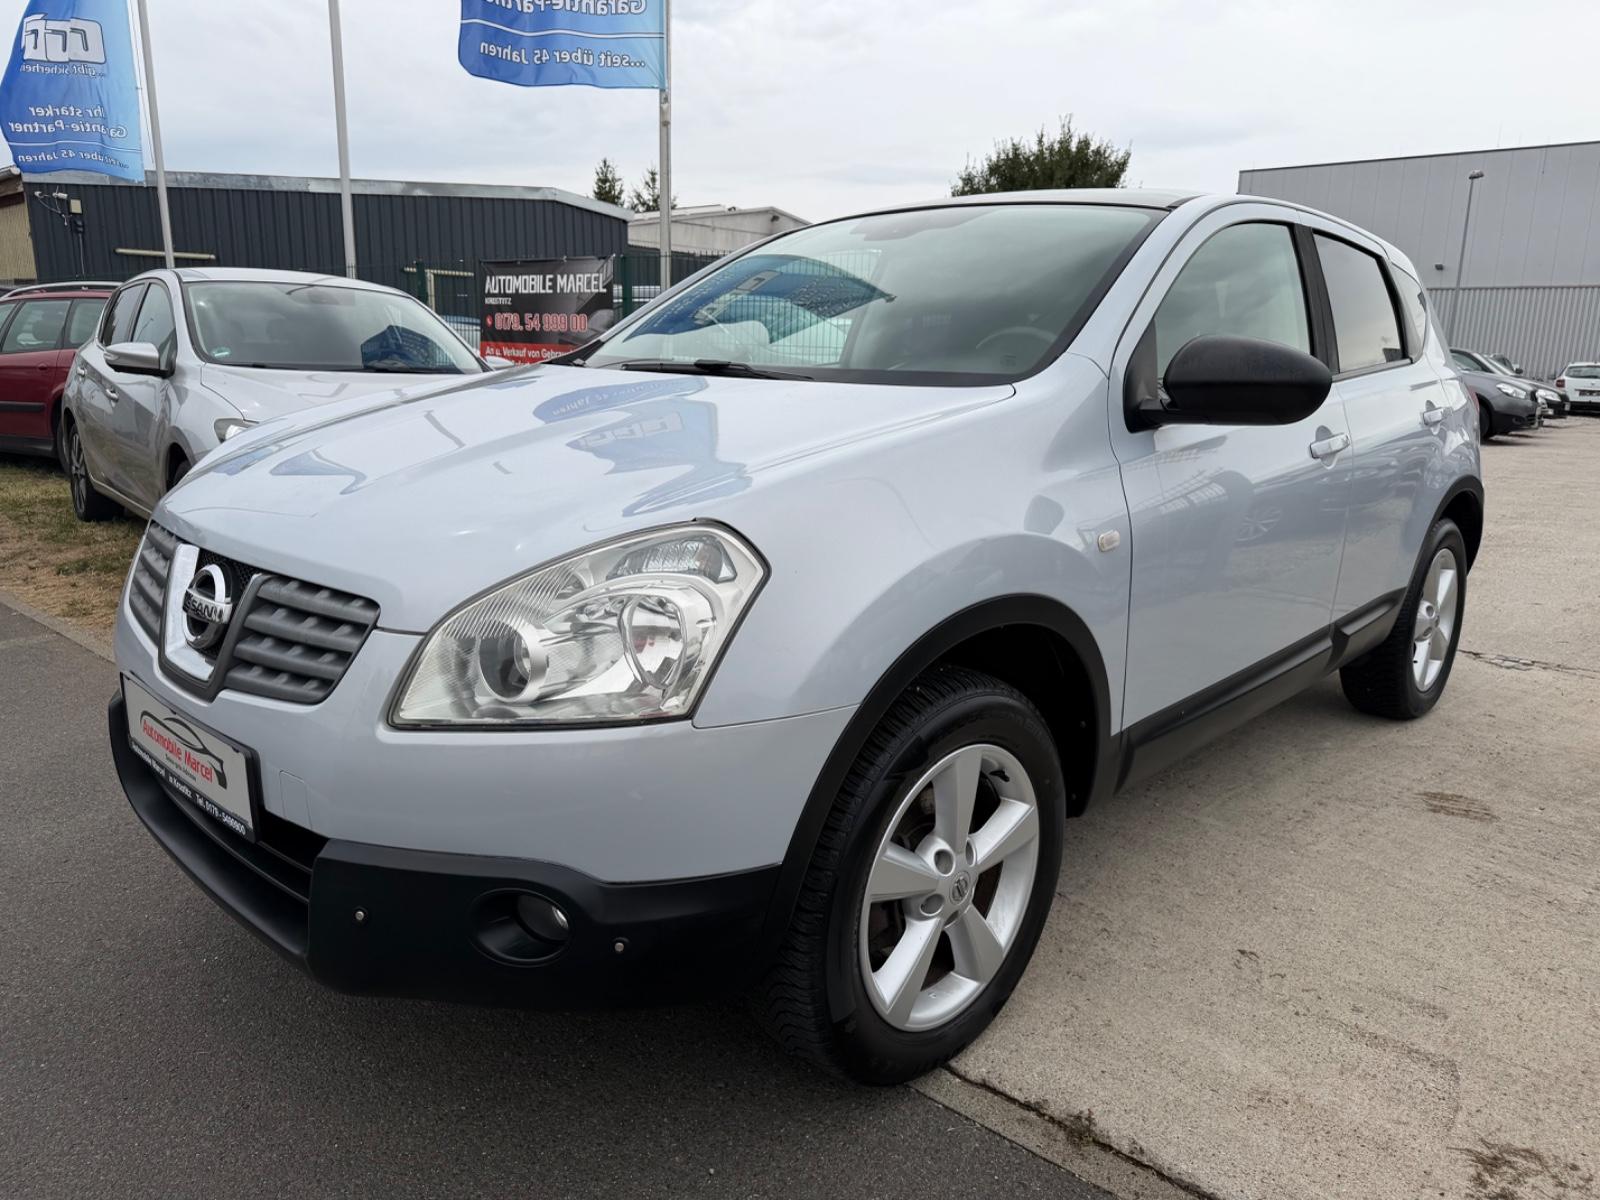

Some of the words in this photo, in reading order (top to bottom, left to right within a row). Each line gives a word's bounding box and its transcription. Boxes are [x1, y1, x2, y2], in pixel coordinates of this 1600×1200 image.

[485, 275, 553, 294] AUTOMOBILE
[556, 273, 607, 293] MARCEL
[524, 313, 541, 332] 54
[542, 313, 568, 332] 999
[569, 313, 588, 332] 00
[503, 346, 526, 358] Verkauf
[527, 350, 540, 358] von
[143, 719, 182, 761] Automobile
[184, 750, 213, 783] Marcel
